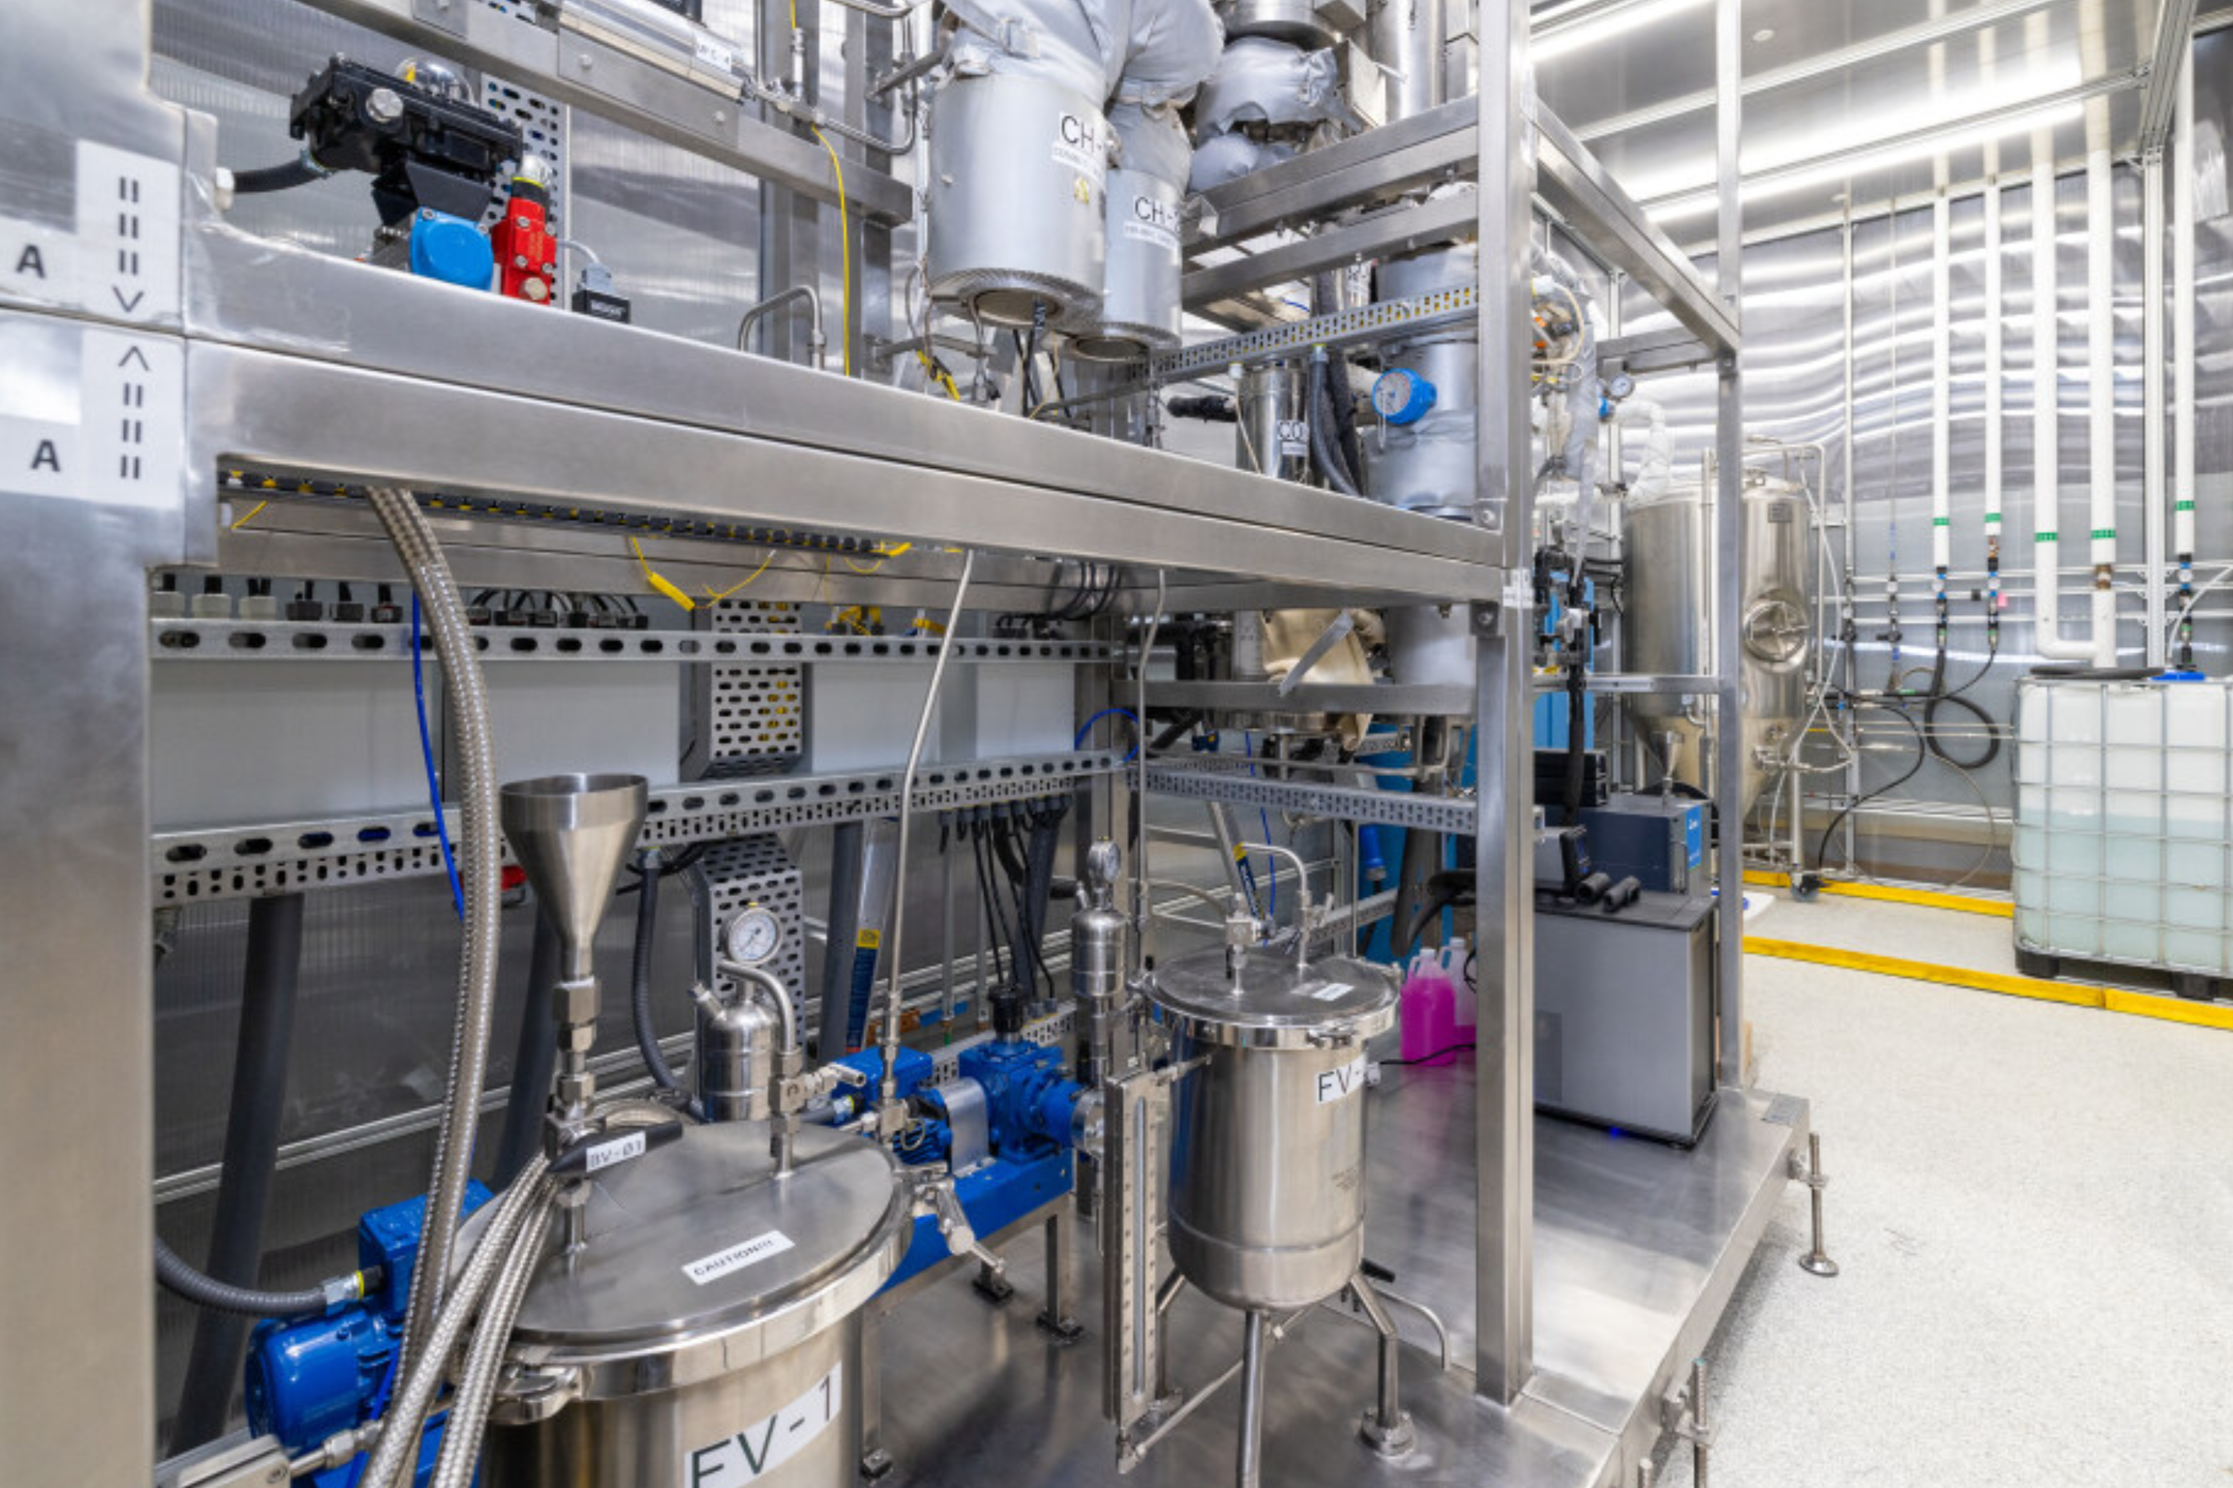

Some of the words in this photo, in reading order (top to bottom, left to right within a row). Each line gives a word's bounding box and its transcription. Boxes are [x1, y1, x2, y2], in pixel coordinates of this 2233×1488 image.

[16, 244, 45, 278] A
[31, 440, 60, 472] A
[692, 1374, 831, 1488] FV-1
